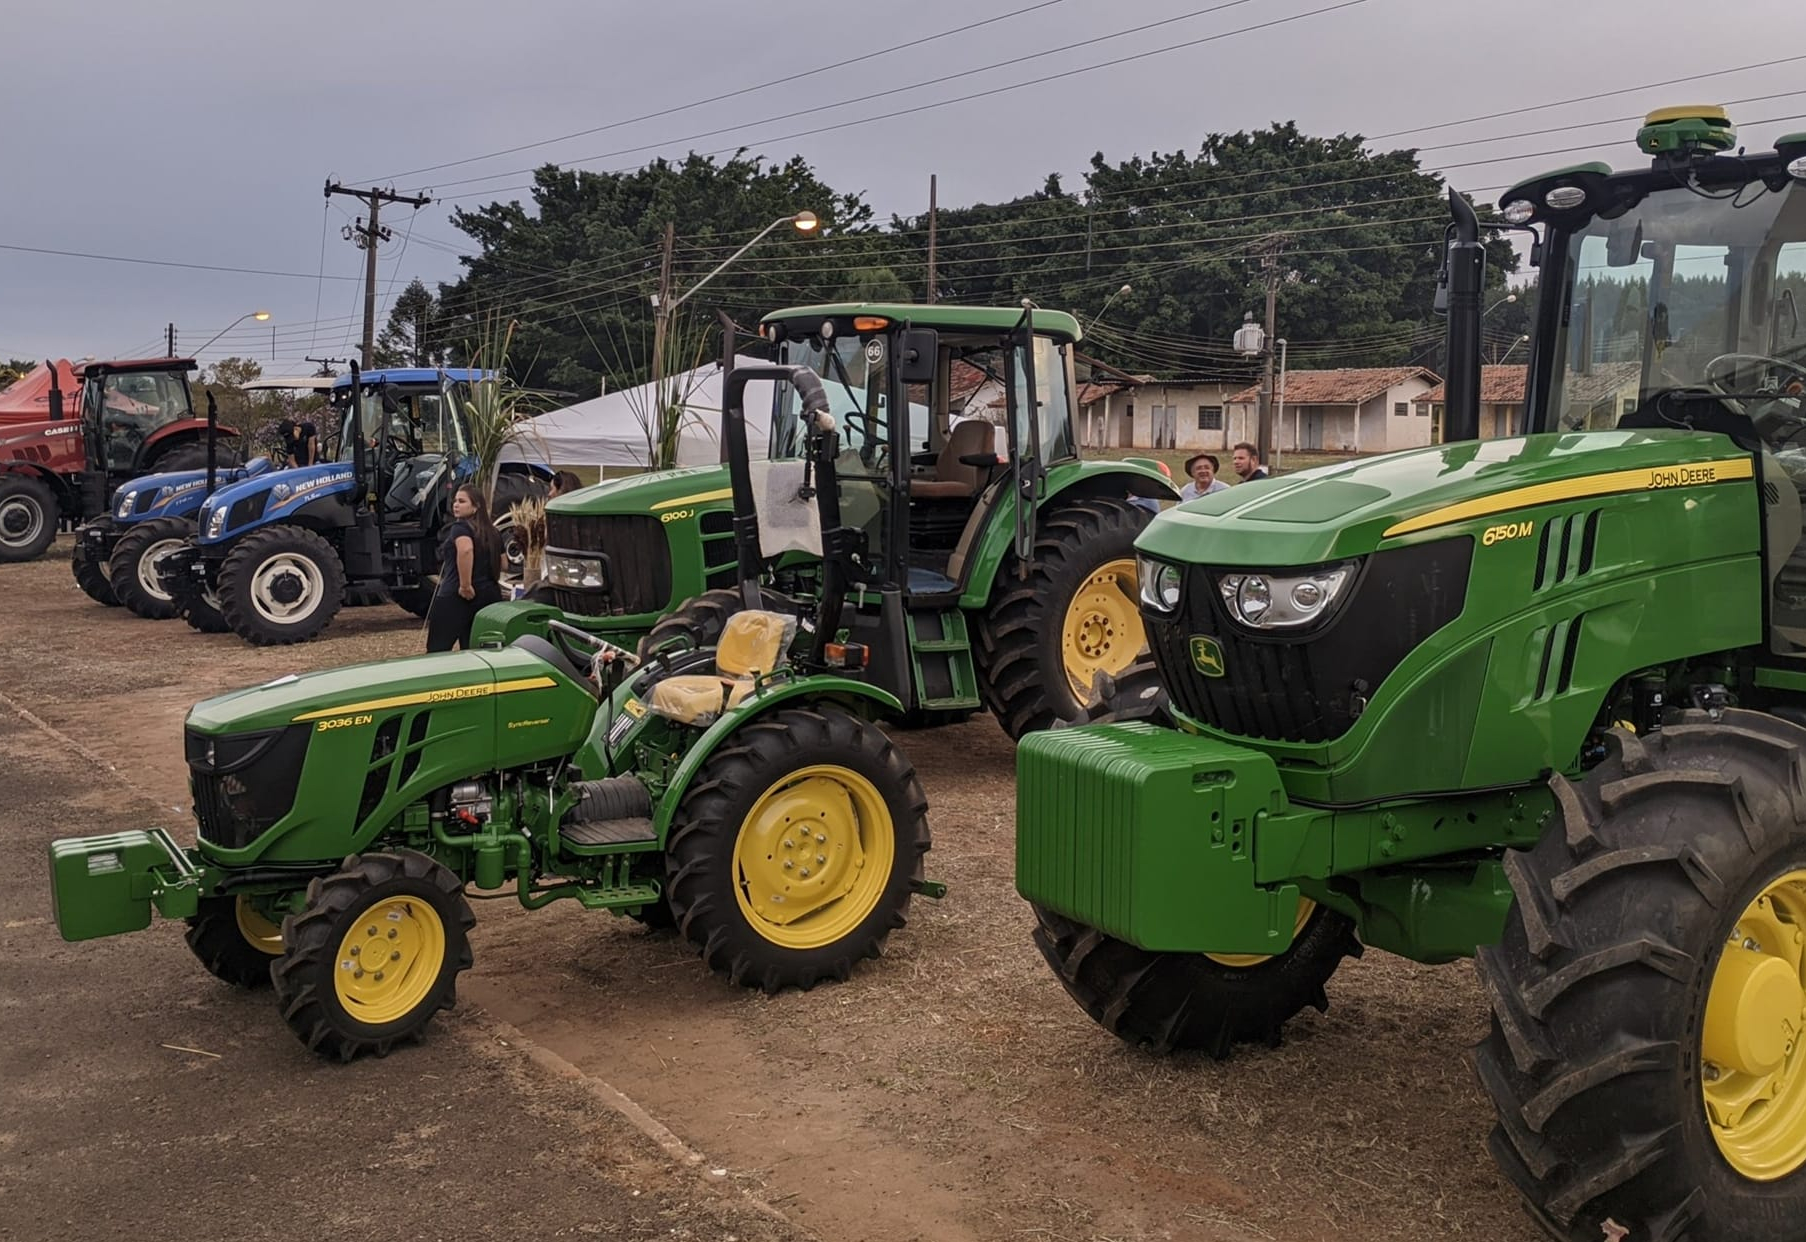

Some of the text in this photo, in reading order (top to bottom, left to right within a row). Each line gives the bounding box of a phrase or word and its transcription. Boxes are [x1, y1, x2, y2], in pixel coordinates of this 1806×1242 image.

[44, 426, 69, 436] CASE
[295, 471, 353, 493] NEW HOLLAND
[1648, 467, 1716, 488] JOHN DEERE
[175, 481, 192, 492] NEW
[660, 510, 688, 523] 6100
[1482, 520, 1534, 546] 6150 M
[427, 686, 489, 702] JOHN DEERE
[316, 714, 373, 732] 3036 EN
